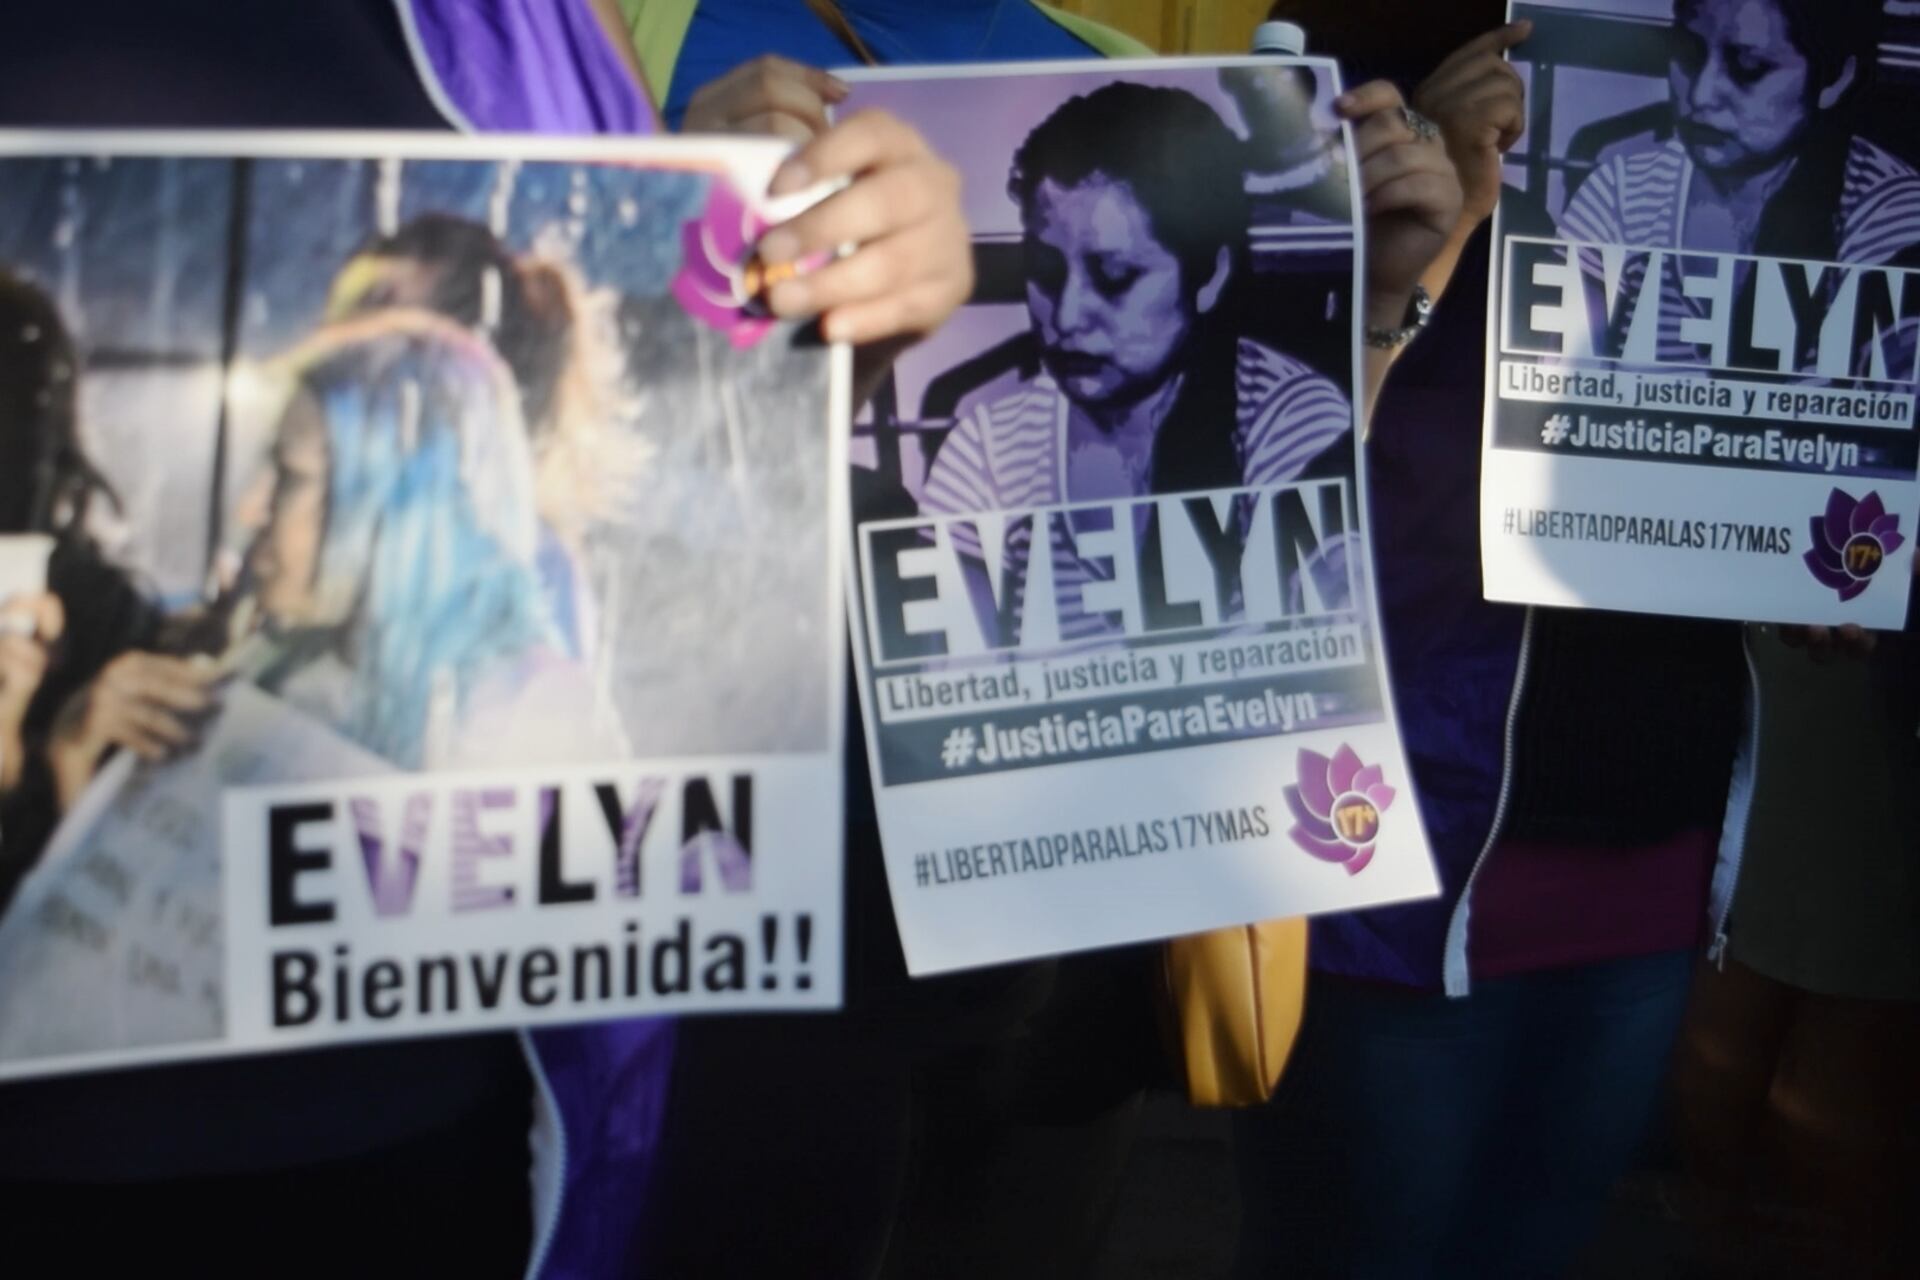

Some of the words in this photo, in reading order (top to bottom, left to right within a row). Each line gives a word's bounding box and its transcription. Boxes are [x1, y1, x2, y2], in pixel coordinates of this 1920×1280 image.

[1510, 239, 1920, 382] EVELYN
[1507, 366, 1624, 404] Libertad,
[1635, 376, 1731, 408] justicia
[1743, 388, 1757, 415] y
[1766, 388, 1909, 422] reparación
[1540, 413, 1859, 472] #JusticiaParaEvelyn
[1503, 507, 1791, 555] #LIBERTADPARALAS17YMAS
[868, 484, 1354, 662] EVELYN
[887, 666, 1031, 711] Libertad,
[1041, 653, 1158, 699] justicia
[1169, 651, 1185, 685] y
[1198, 628, 1357, 678] reparación
[941, 687, 1318, 769] #JusticiaParaEvelyn
[268, 774, 753, 927] EVELYN
[915, 806, 1270, 887] #LIBERTADPARALAS17YMAS
[272, 914, 812, 1029] Bienvenida!!
